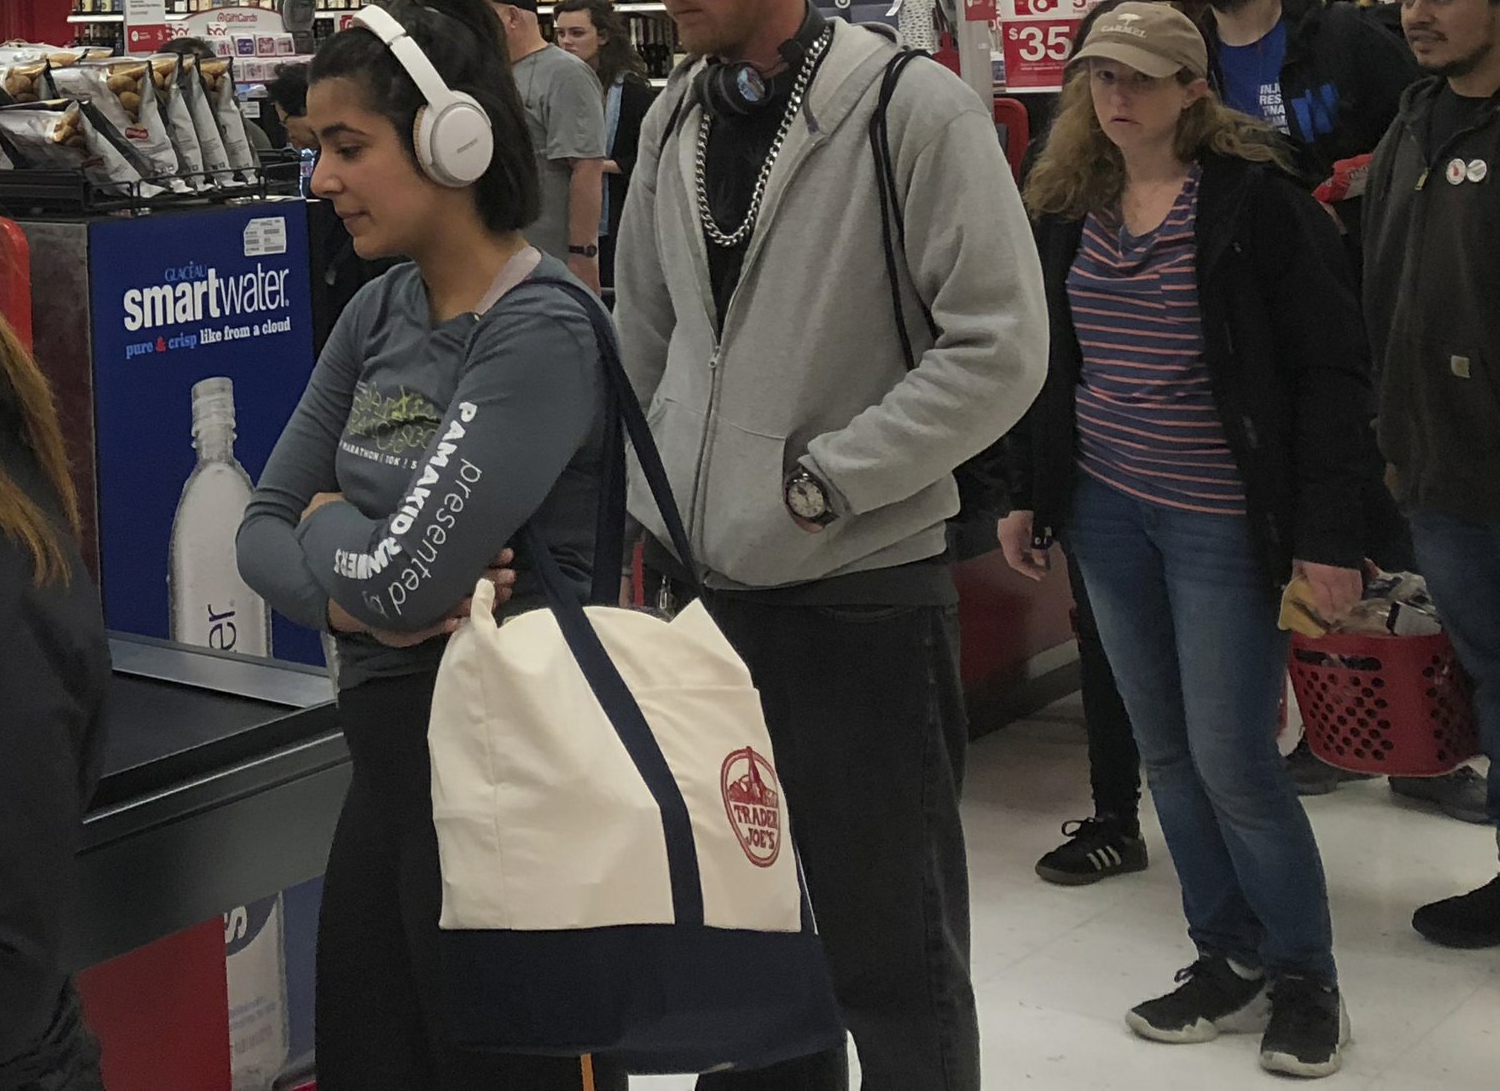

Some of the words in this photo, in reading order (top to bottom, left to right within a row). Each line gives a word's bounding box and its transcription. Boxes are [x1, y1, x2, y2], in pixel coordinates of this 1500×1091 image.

[1008, 25, 1073, 61] $35
[123, 262, 290, 331] smartwater
[126, 341, 153, 359] pure
[155, 336, 166, 352] &
[168, 332, 197, 349] crisp
[200, 329, 222, 344] like
[224, 324, 250, 340] from
[253, 326, 260, 336] a
[262, 316, 291, 335] cloud
[342, 440, 379, 462] MARATHON
[385, 456, 400, 466] 10K
[411, 460, 418, 469] 5
[387, 458, 483, 616] presented
[745, 827, 775, 850] JOE'S
